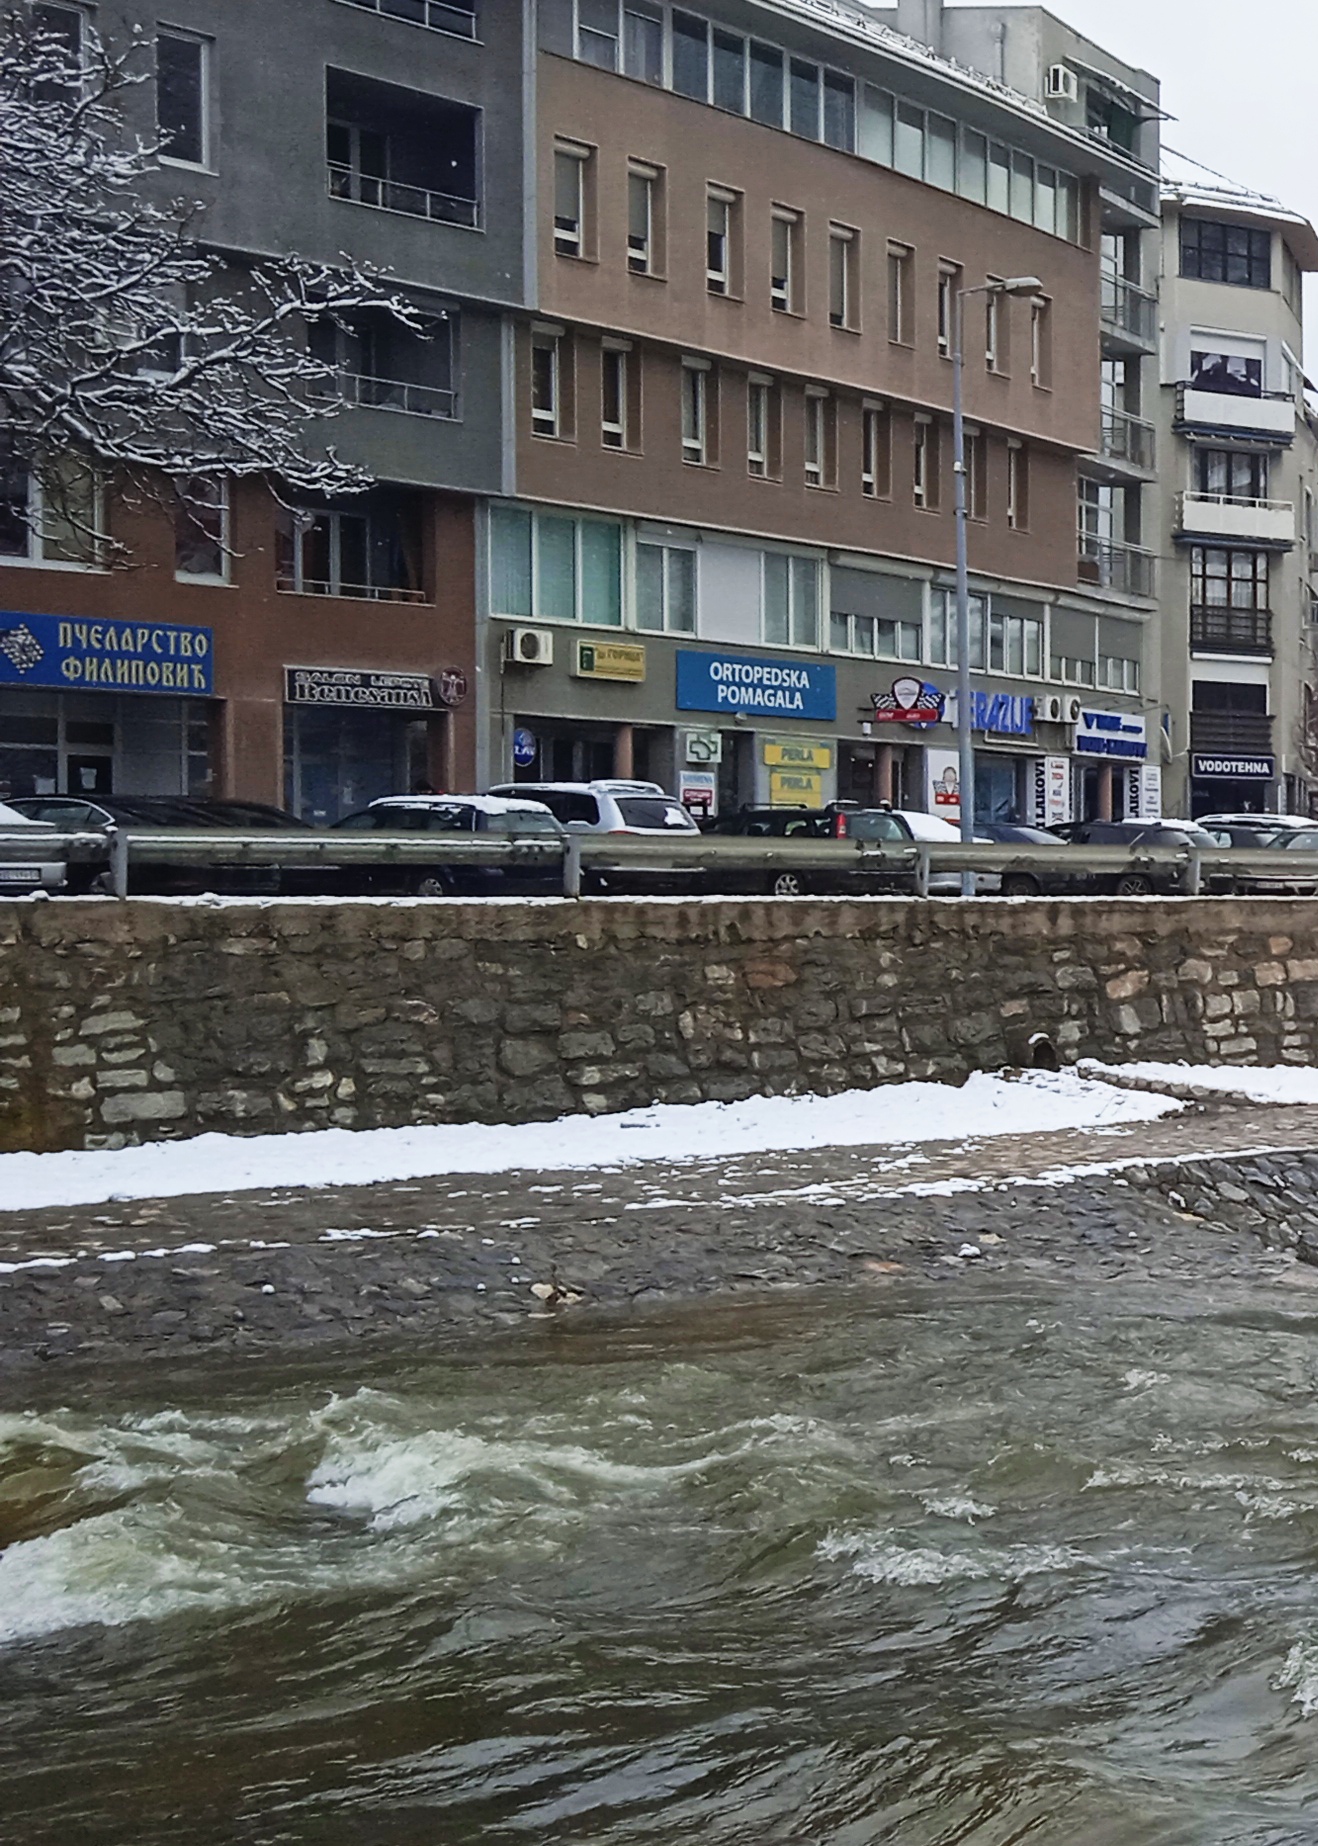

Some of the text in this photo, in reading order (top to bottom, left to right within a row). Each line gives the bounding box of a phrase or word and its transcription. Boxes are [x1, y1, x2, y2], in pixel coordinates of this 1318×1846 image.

[58, 622, 209, 658] ПЧЕЛАРСТВО
[61, 655, 207, 690] ФИЛИПОВИЋ
[295, 671, 361, 685] SALON
[709, 661, 810, 689] ORTOPEDSKA
[717, 684, 804, 709] POMAGALA
[781, 747, 814, 761] PERLA
[1198, 759, 1270, 774] VODOTEHNA
[1035, 761, 1045, 819] LAKOVI
